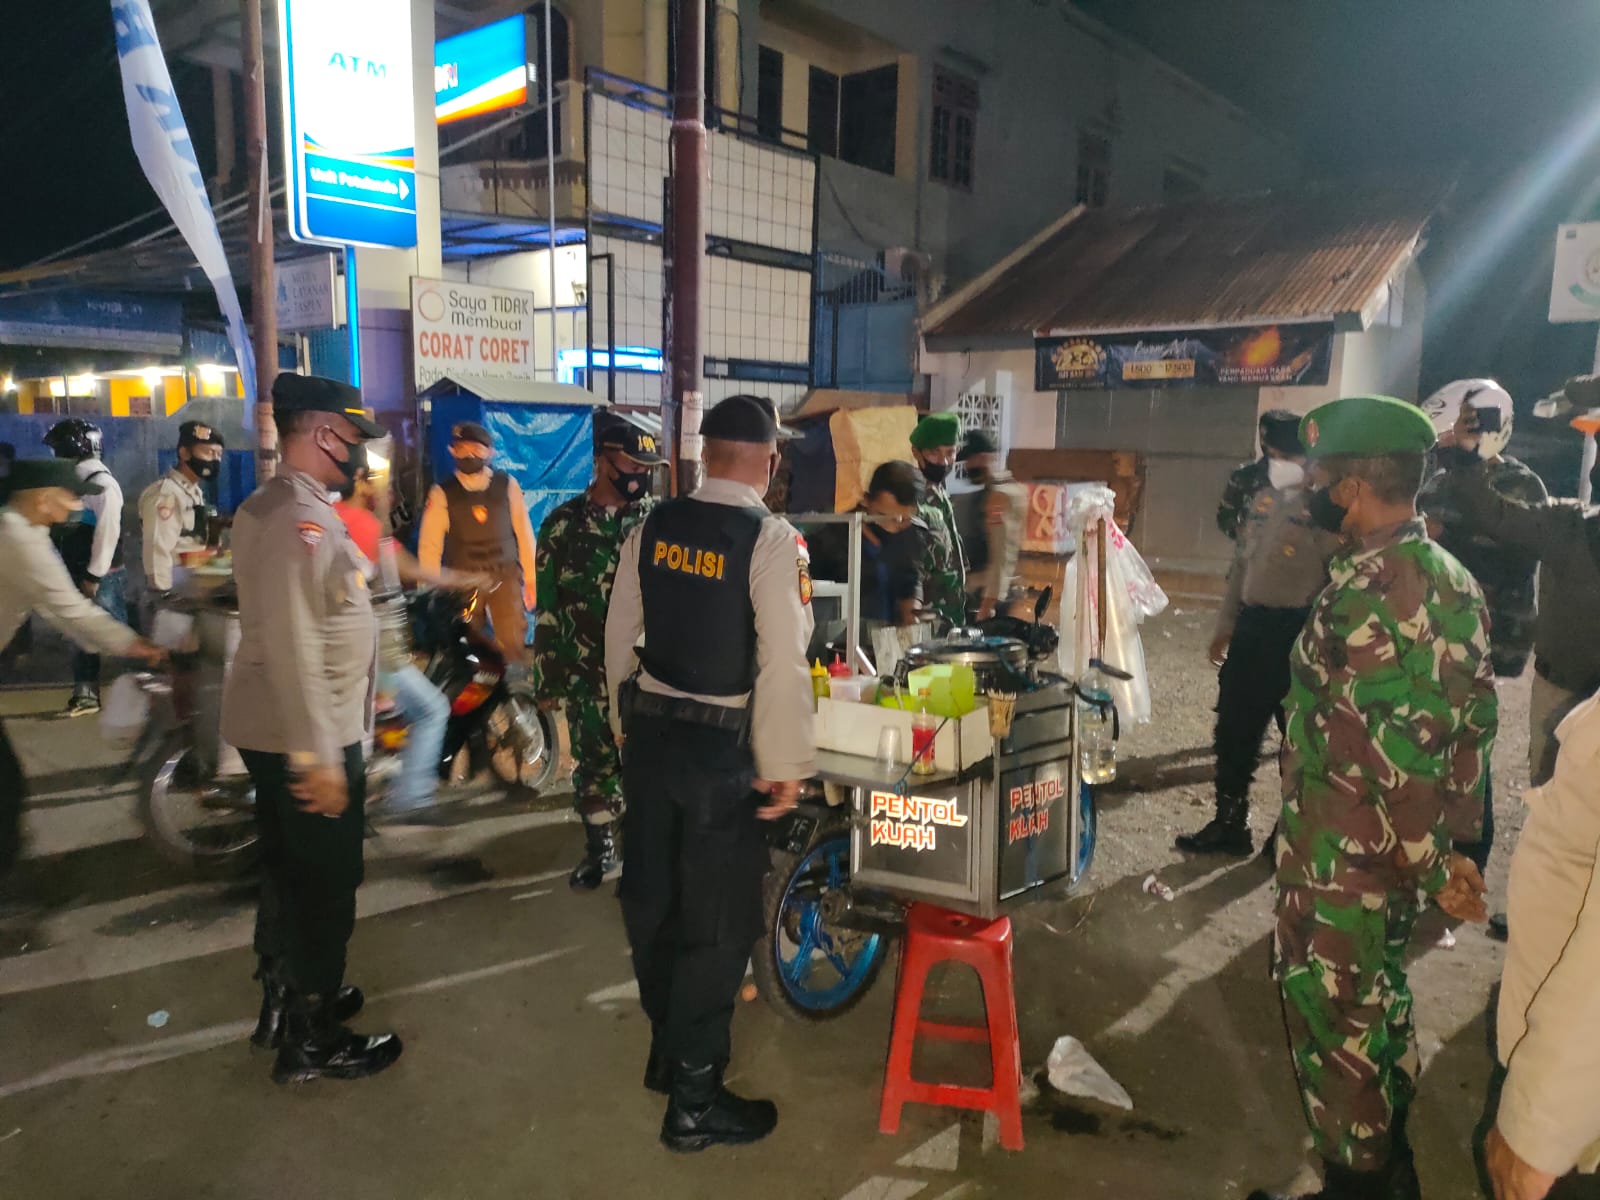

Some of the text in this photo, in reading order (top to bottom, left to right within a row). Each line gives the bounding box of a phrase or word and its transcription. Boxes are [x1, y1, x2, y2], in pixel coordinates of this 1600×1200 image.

[327, 51, 387, 78] ATM
[449, 290, 529, 316] Saya TIDAK
[451, 311, 522, 331] Membuat
[419, 330, 530, 364] CORAT CORET
[653, 540, 725, 580] POLISI
[871, 790, 967, 827] PENTOL
[1010, 776, 1064, 816] PENTOL
[871, 818, 936, 852] KUAH
